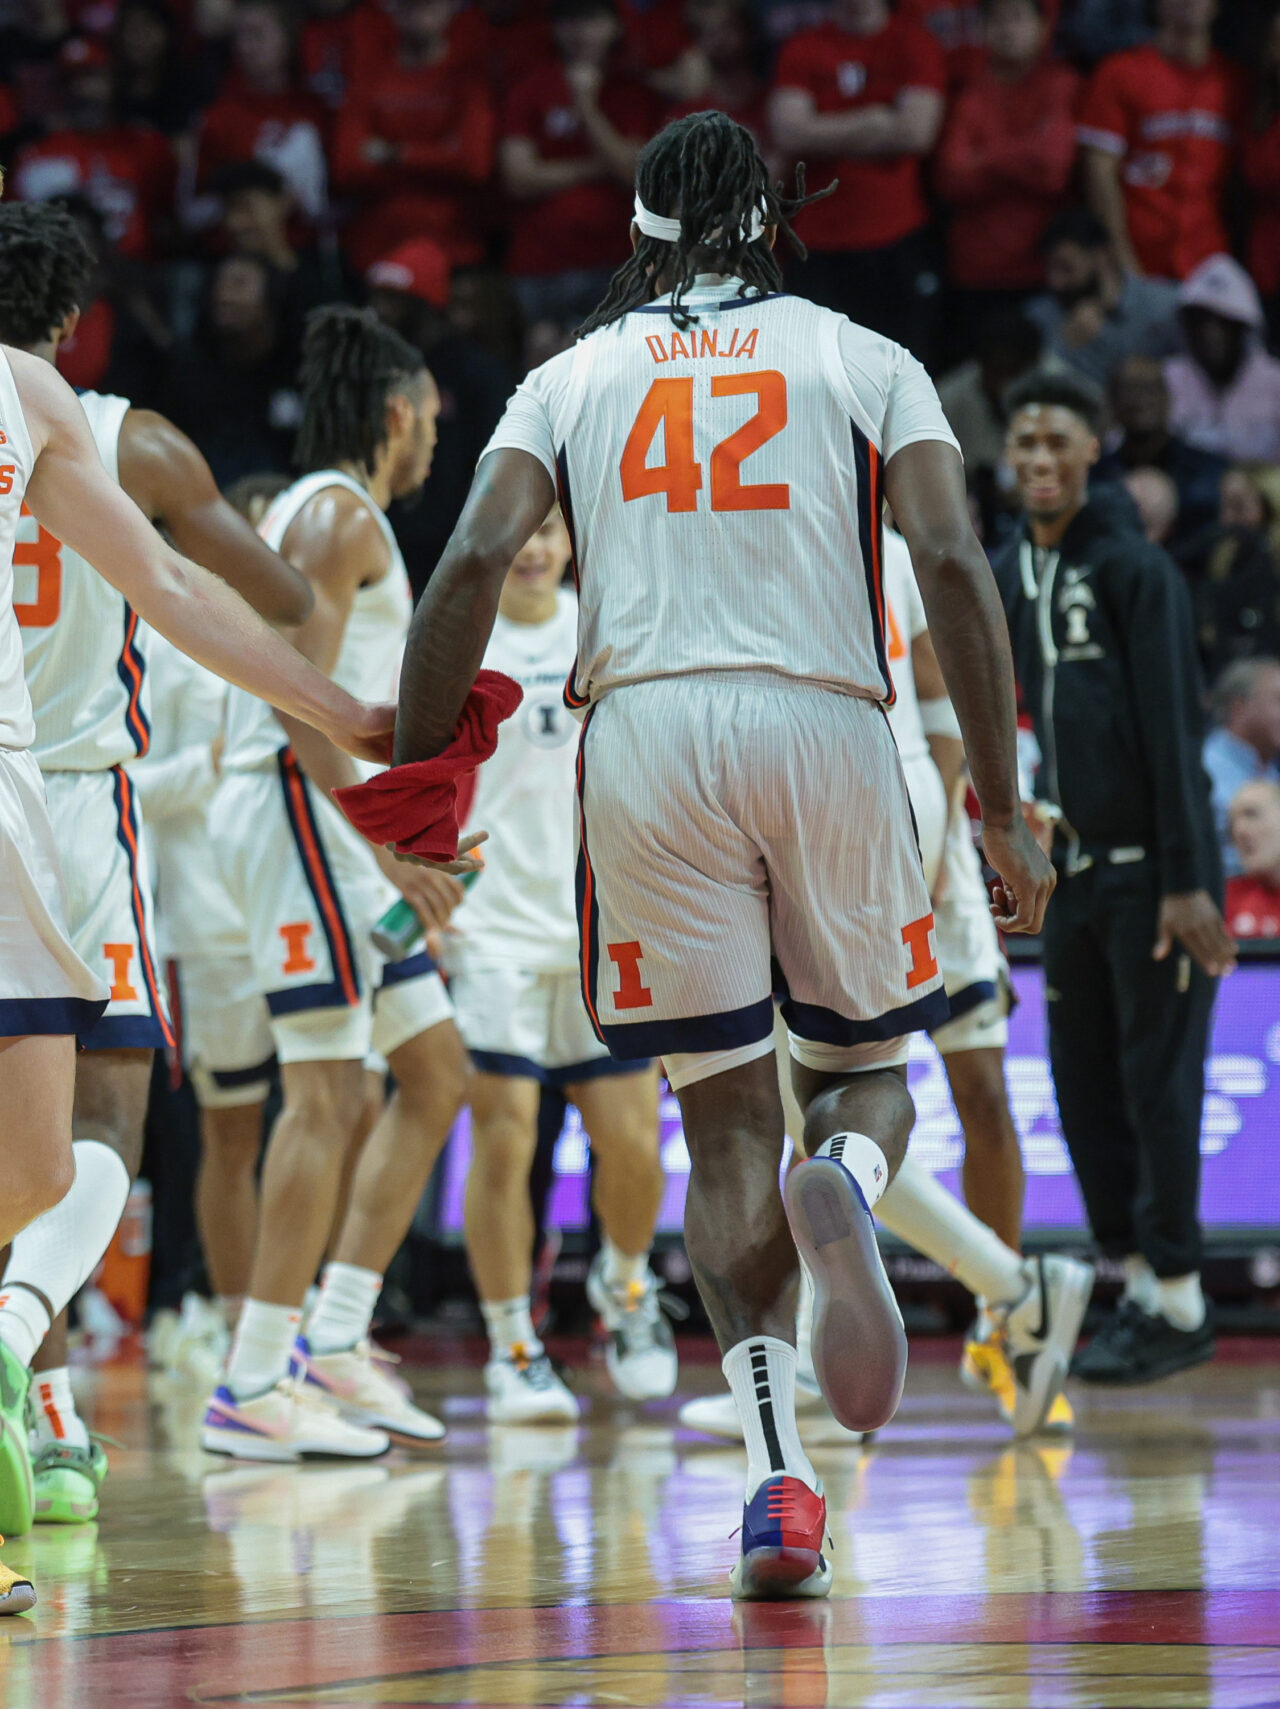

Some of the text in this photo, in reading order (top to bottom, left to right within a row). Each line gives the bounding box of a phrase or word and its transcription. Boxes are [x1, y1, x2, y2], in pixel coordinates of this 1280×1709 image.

[645, 327, 759, 363] DAINJA
[619, 369, 790, 513] 42
[103, 943, 138, 1001] I
[279, 921, 315, 975] I
[607, 941, 653, 1009] I
[901, 912, 938, 990] I
